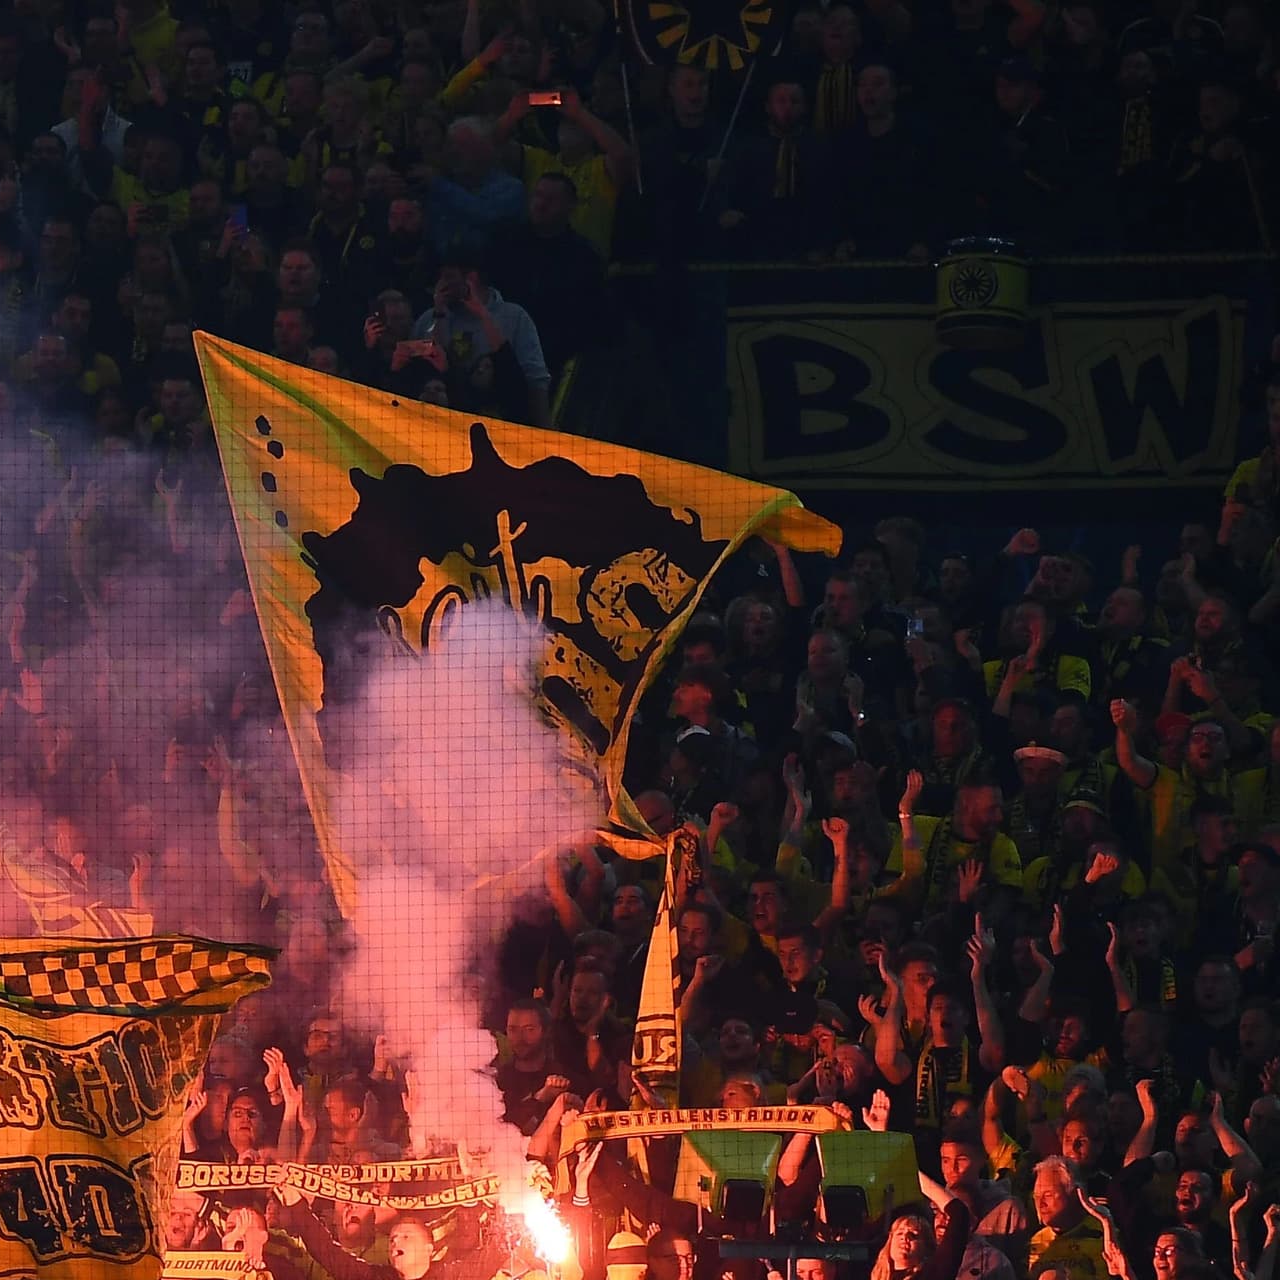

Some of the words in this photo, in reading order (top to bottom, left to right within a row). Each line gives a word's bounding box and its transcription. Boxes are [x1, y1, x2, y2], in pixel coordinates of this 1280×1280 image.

[748, 303, 1221, 473] BSW
[178, 1163, 283, 1189] BORUSS
[361, 1161, 462, 1184] DORTMU
[287, 1165, 379, 1206] RUSSIA
